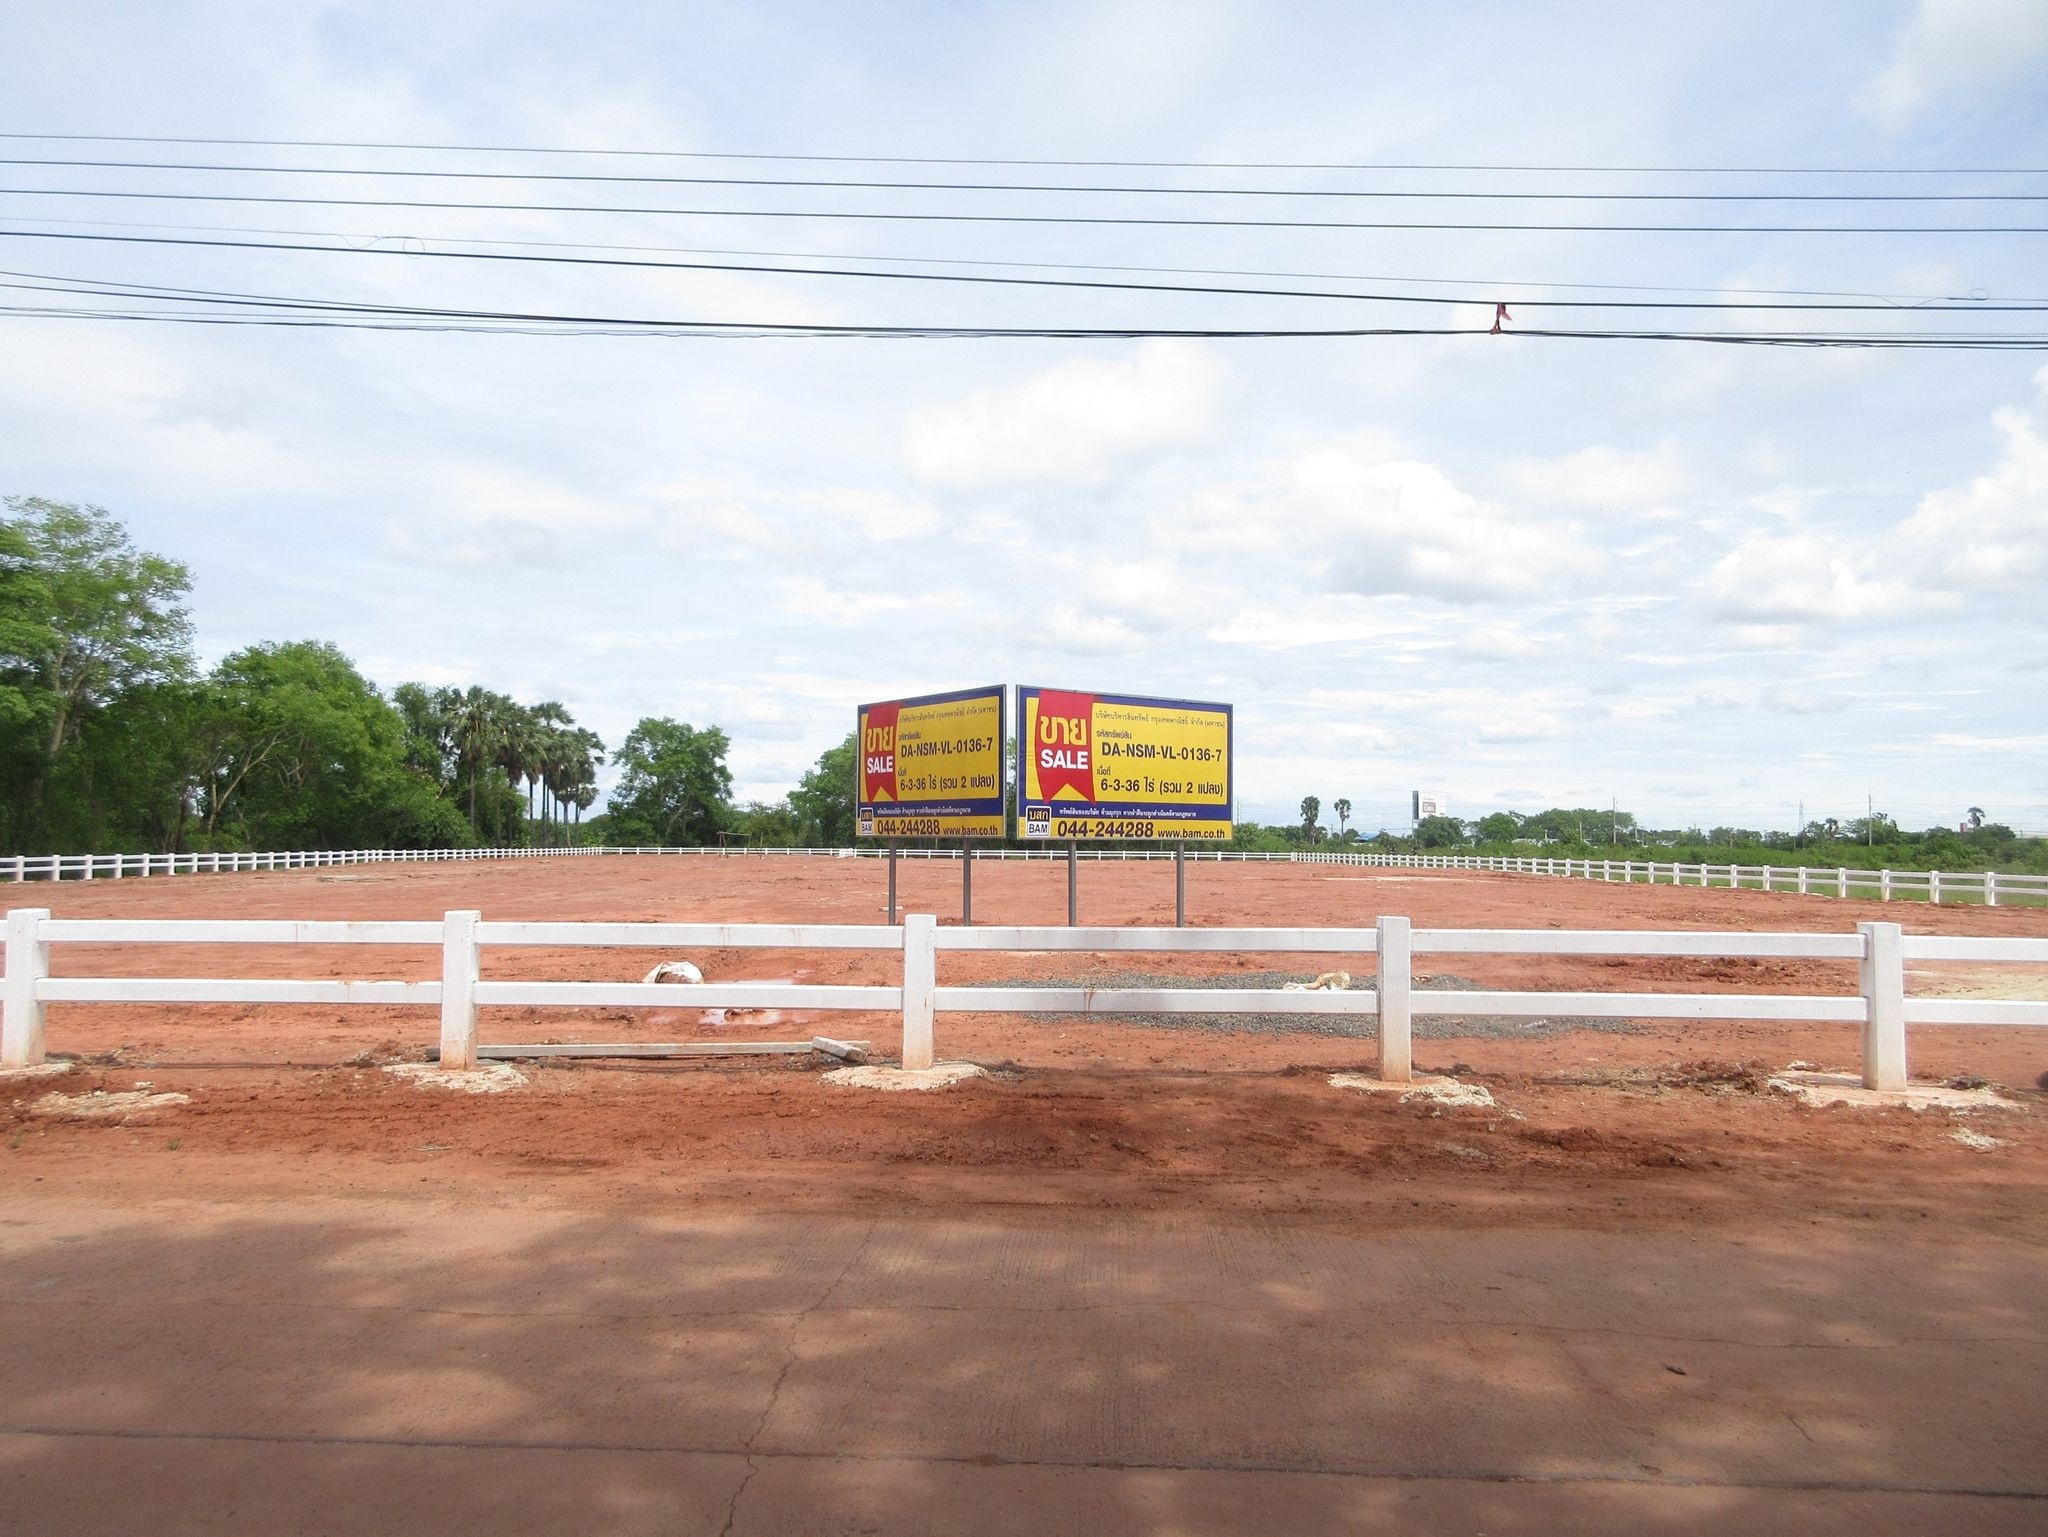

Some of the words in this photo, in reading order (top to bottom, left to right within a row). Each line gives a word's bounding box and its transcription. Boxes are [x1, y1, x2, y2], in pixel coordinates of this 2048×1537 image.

[867, 726, 893, 752] ขาย
[1040, 716, 1087, 746] ขาย
[901, 737, 993, 758] DA-NSM-VL-0136-7
[1101, 742, 1222, 763] DA-NSM-VL-0136-7
[866, 755, 893, 774] SALE
[1040, 749, 1089, 770] SALE
[900, 778, 926, 791] 6-3-36
[928, 774, 937, 790] ไร่
[940, 775, 958, 792] (รวม
[961, 776, 967, 788] 2
[970, 774, 995, 790] แปลง)
[1100, 778, 1140, 792] 6-3-36
[1143, 776, 1155, 792] ไร่
[1159, 780, 1182, 795] (รวม
[1186, 781, 1193, 794] 2
[1198, 781, 1224, 797] แปลง)
[1029, 810, 1049, 821] บสก
[877, 819, 940, 835] 044-244288
[943, 824, 998, 836] www.bam.co.th
[1029, 824, 1048, 833] BAM
[1057, 821, 1154, 838] 044-244288
[1157, 828, 1225, 839] www.bam.co.th
